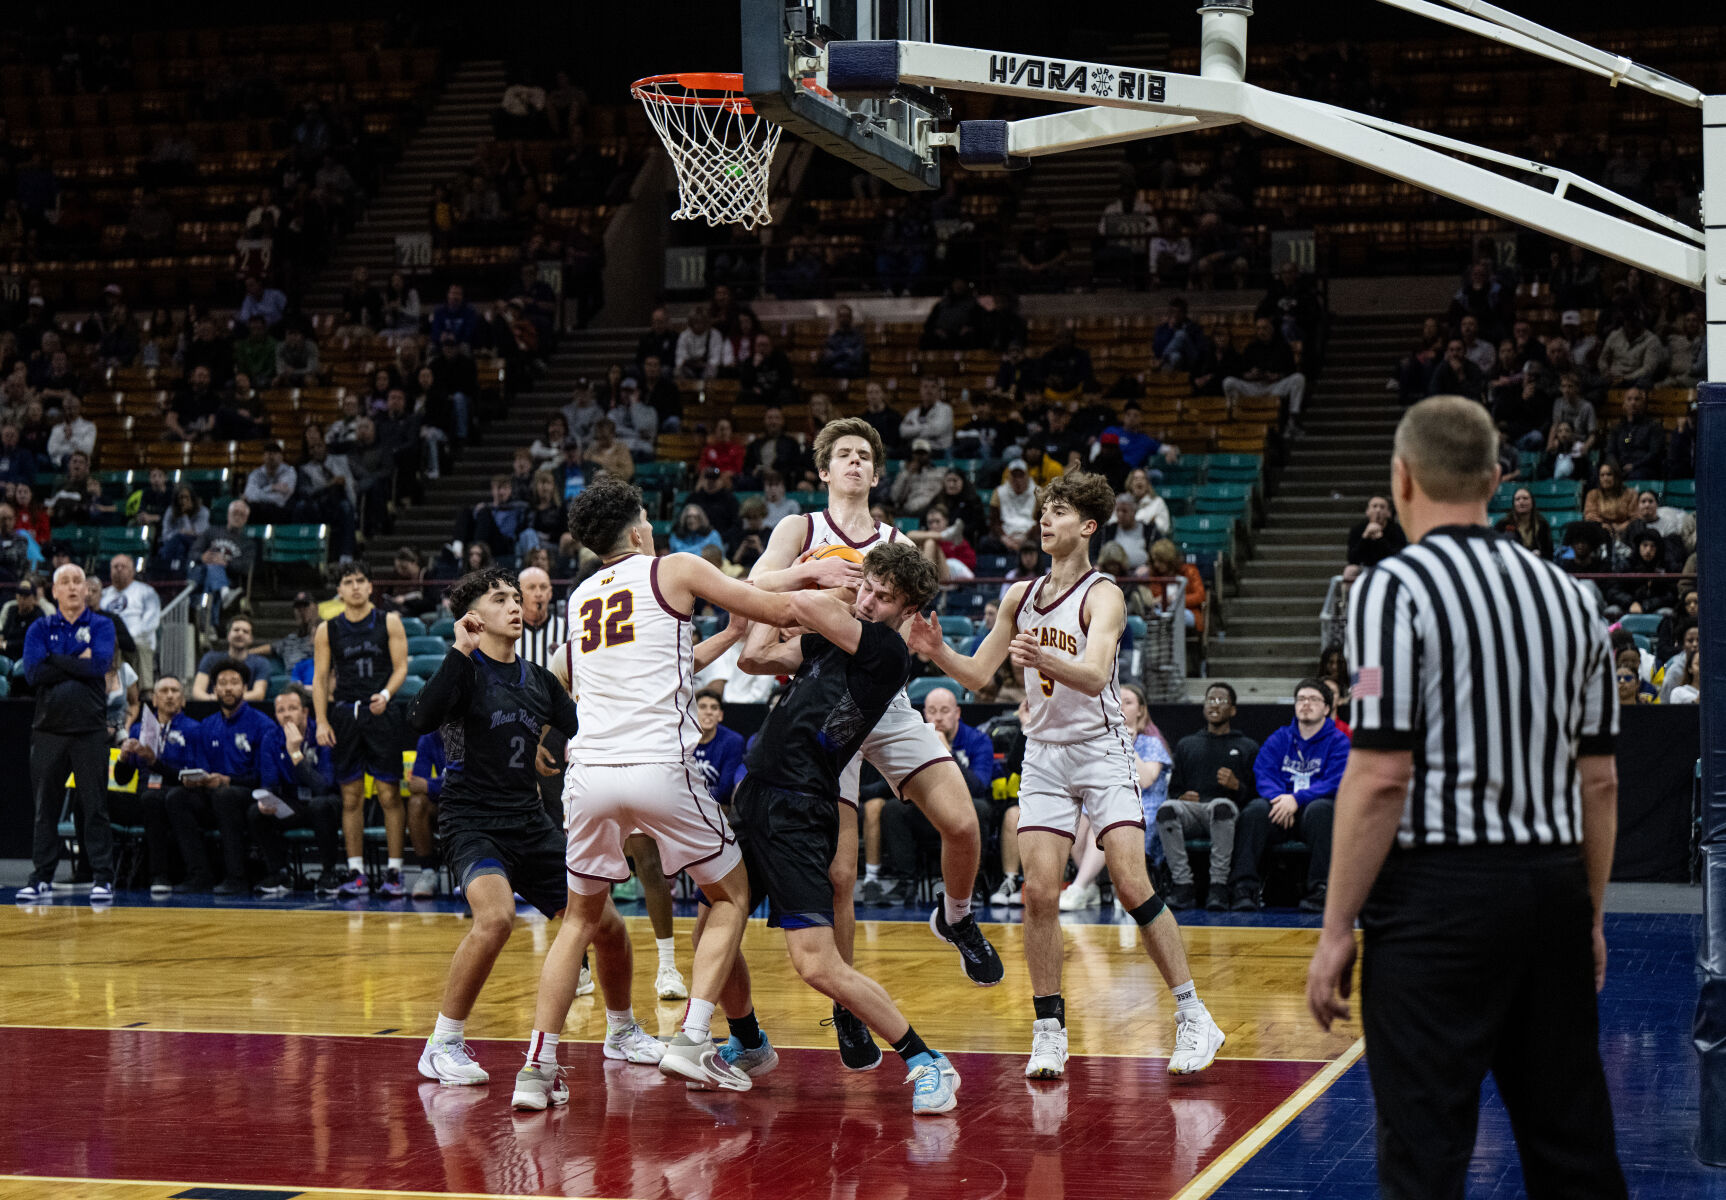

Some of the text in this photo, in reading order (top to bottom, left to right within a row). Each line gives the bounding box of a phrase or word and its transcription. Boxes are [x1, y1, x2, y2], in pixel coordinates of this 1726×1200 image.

[990, 54, 1167, 102] HYDRA RIB
[1091, 67, 1115, 81] SURE
[1091, 83, 1113, 96] SHOT
[1494, 240, 1517, 268] 12
[579, 588, 636, 654] 32
[1032, 626, 1078, 656] ZARDS
[355, 657, 374, 678] 11
[508, 736, 526, 769] 2
